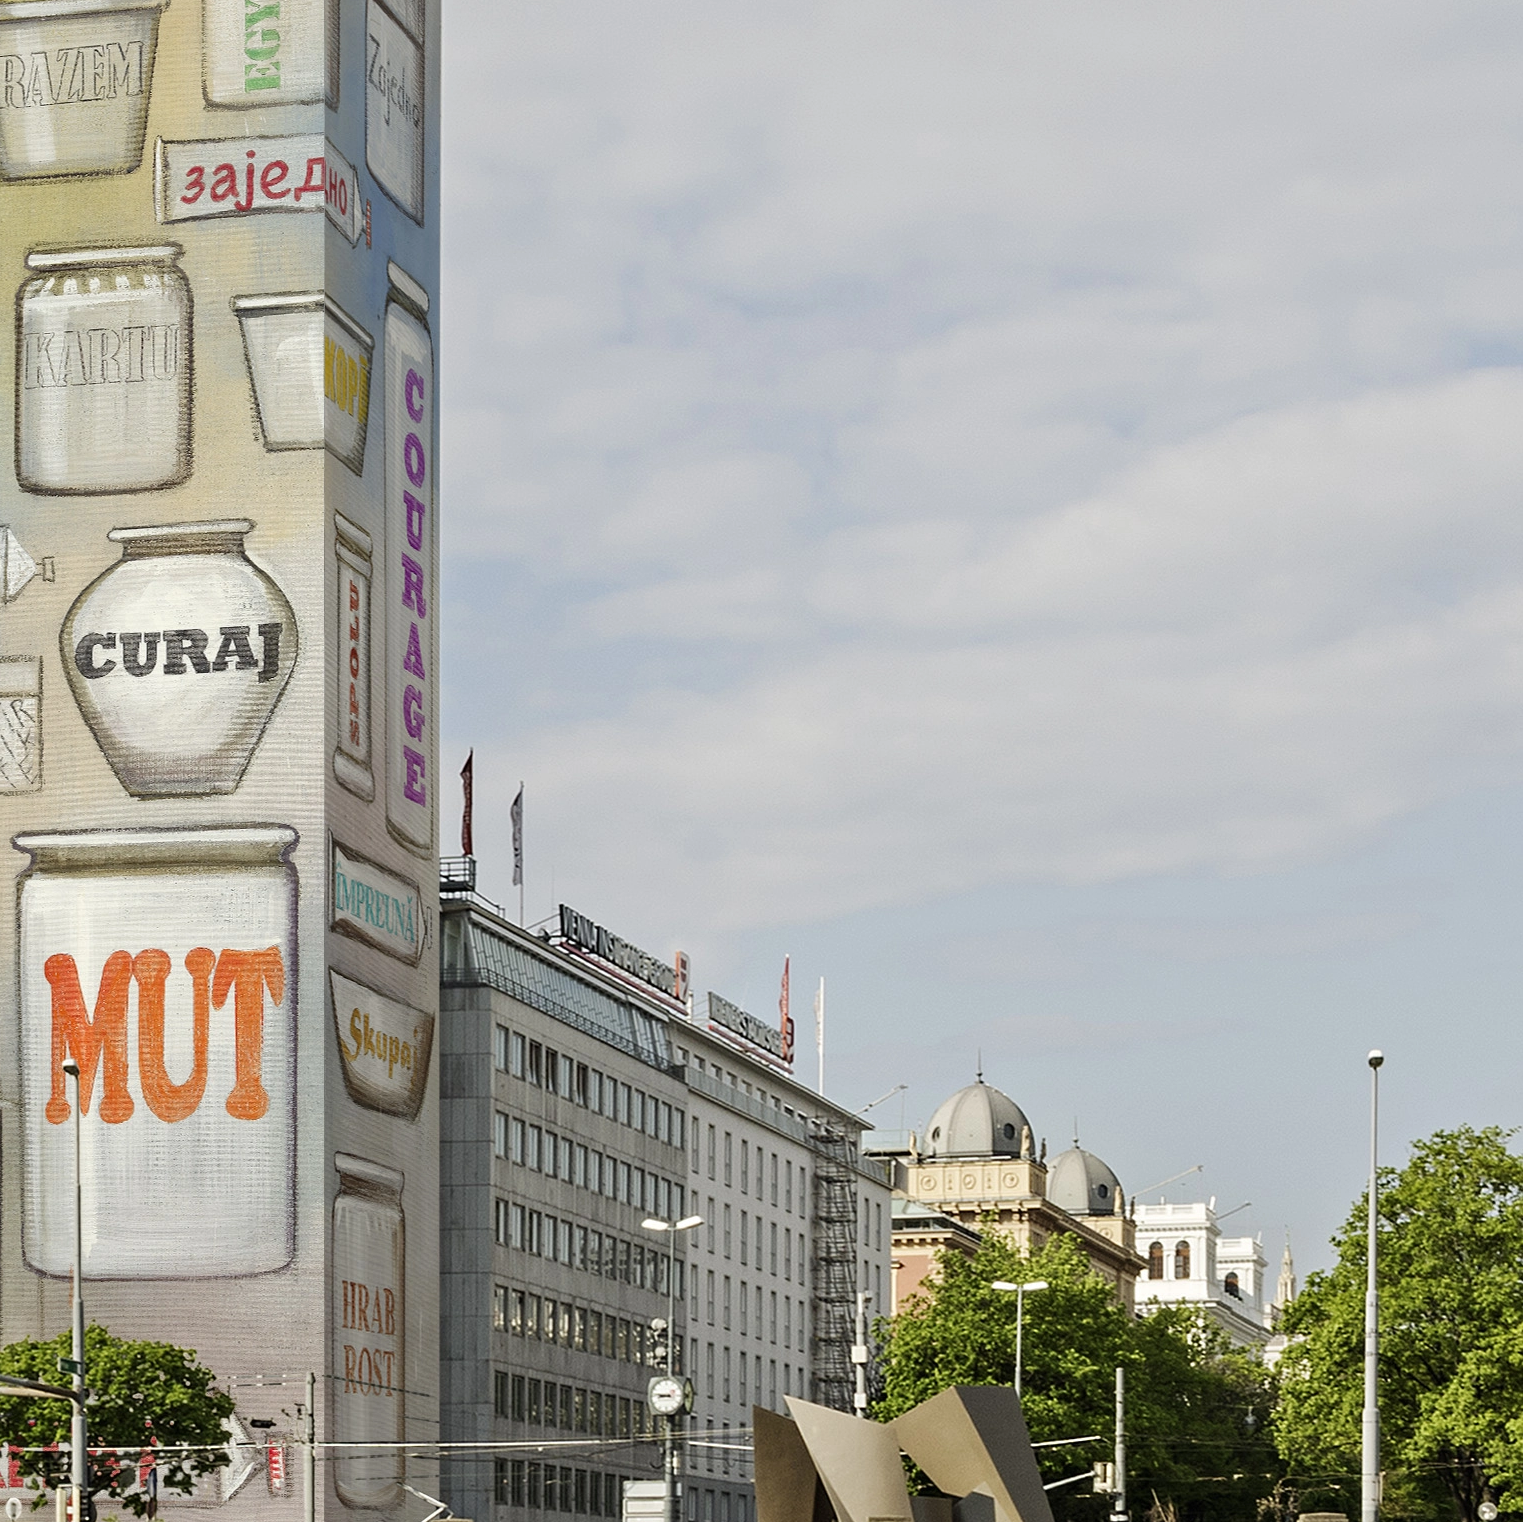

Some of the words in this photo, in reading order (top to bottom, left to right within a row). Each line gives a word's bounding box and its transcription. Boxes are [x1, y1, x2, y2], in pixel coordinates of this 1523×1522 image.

[23, 323, 180, 389] KARTU
[403, 367, 426, 808] COURAGE
[74, 625, 281, 681] CURAJ
[348, 579, 360, 748] SPOLU
[44, 946, 285, 1125] MUT
[341, 1007, 419, 1092] Skupaj
[342, 1280, 395, 1335] HRAB
[343, 1345, 395, 1397] ROST
